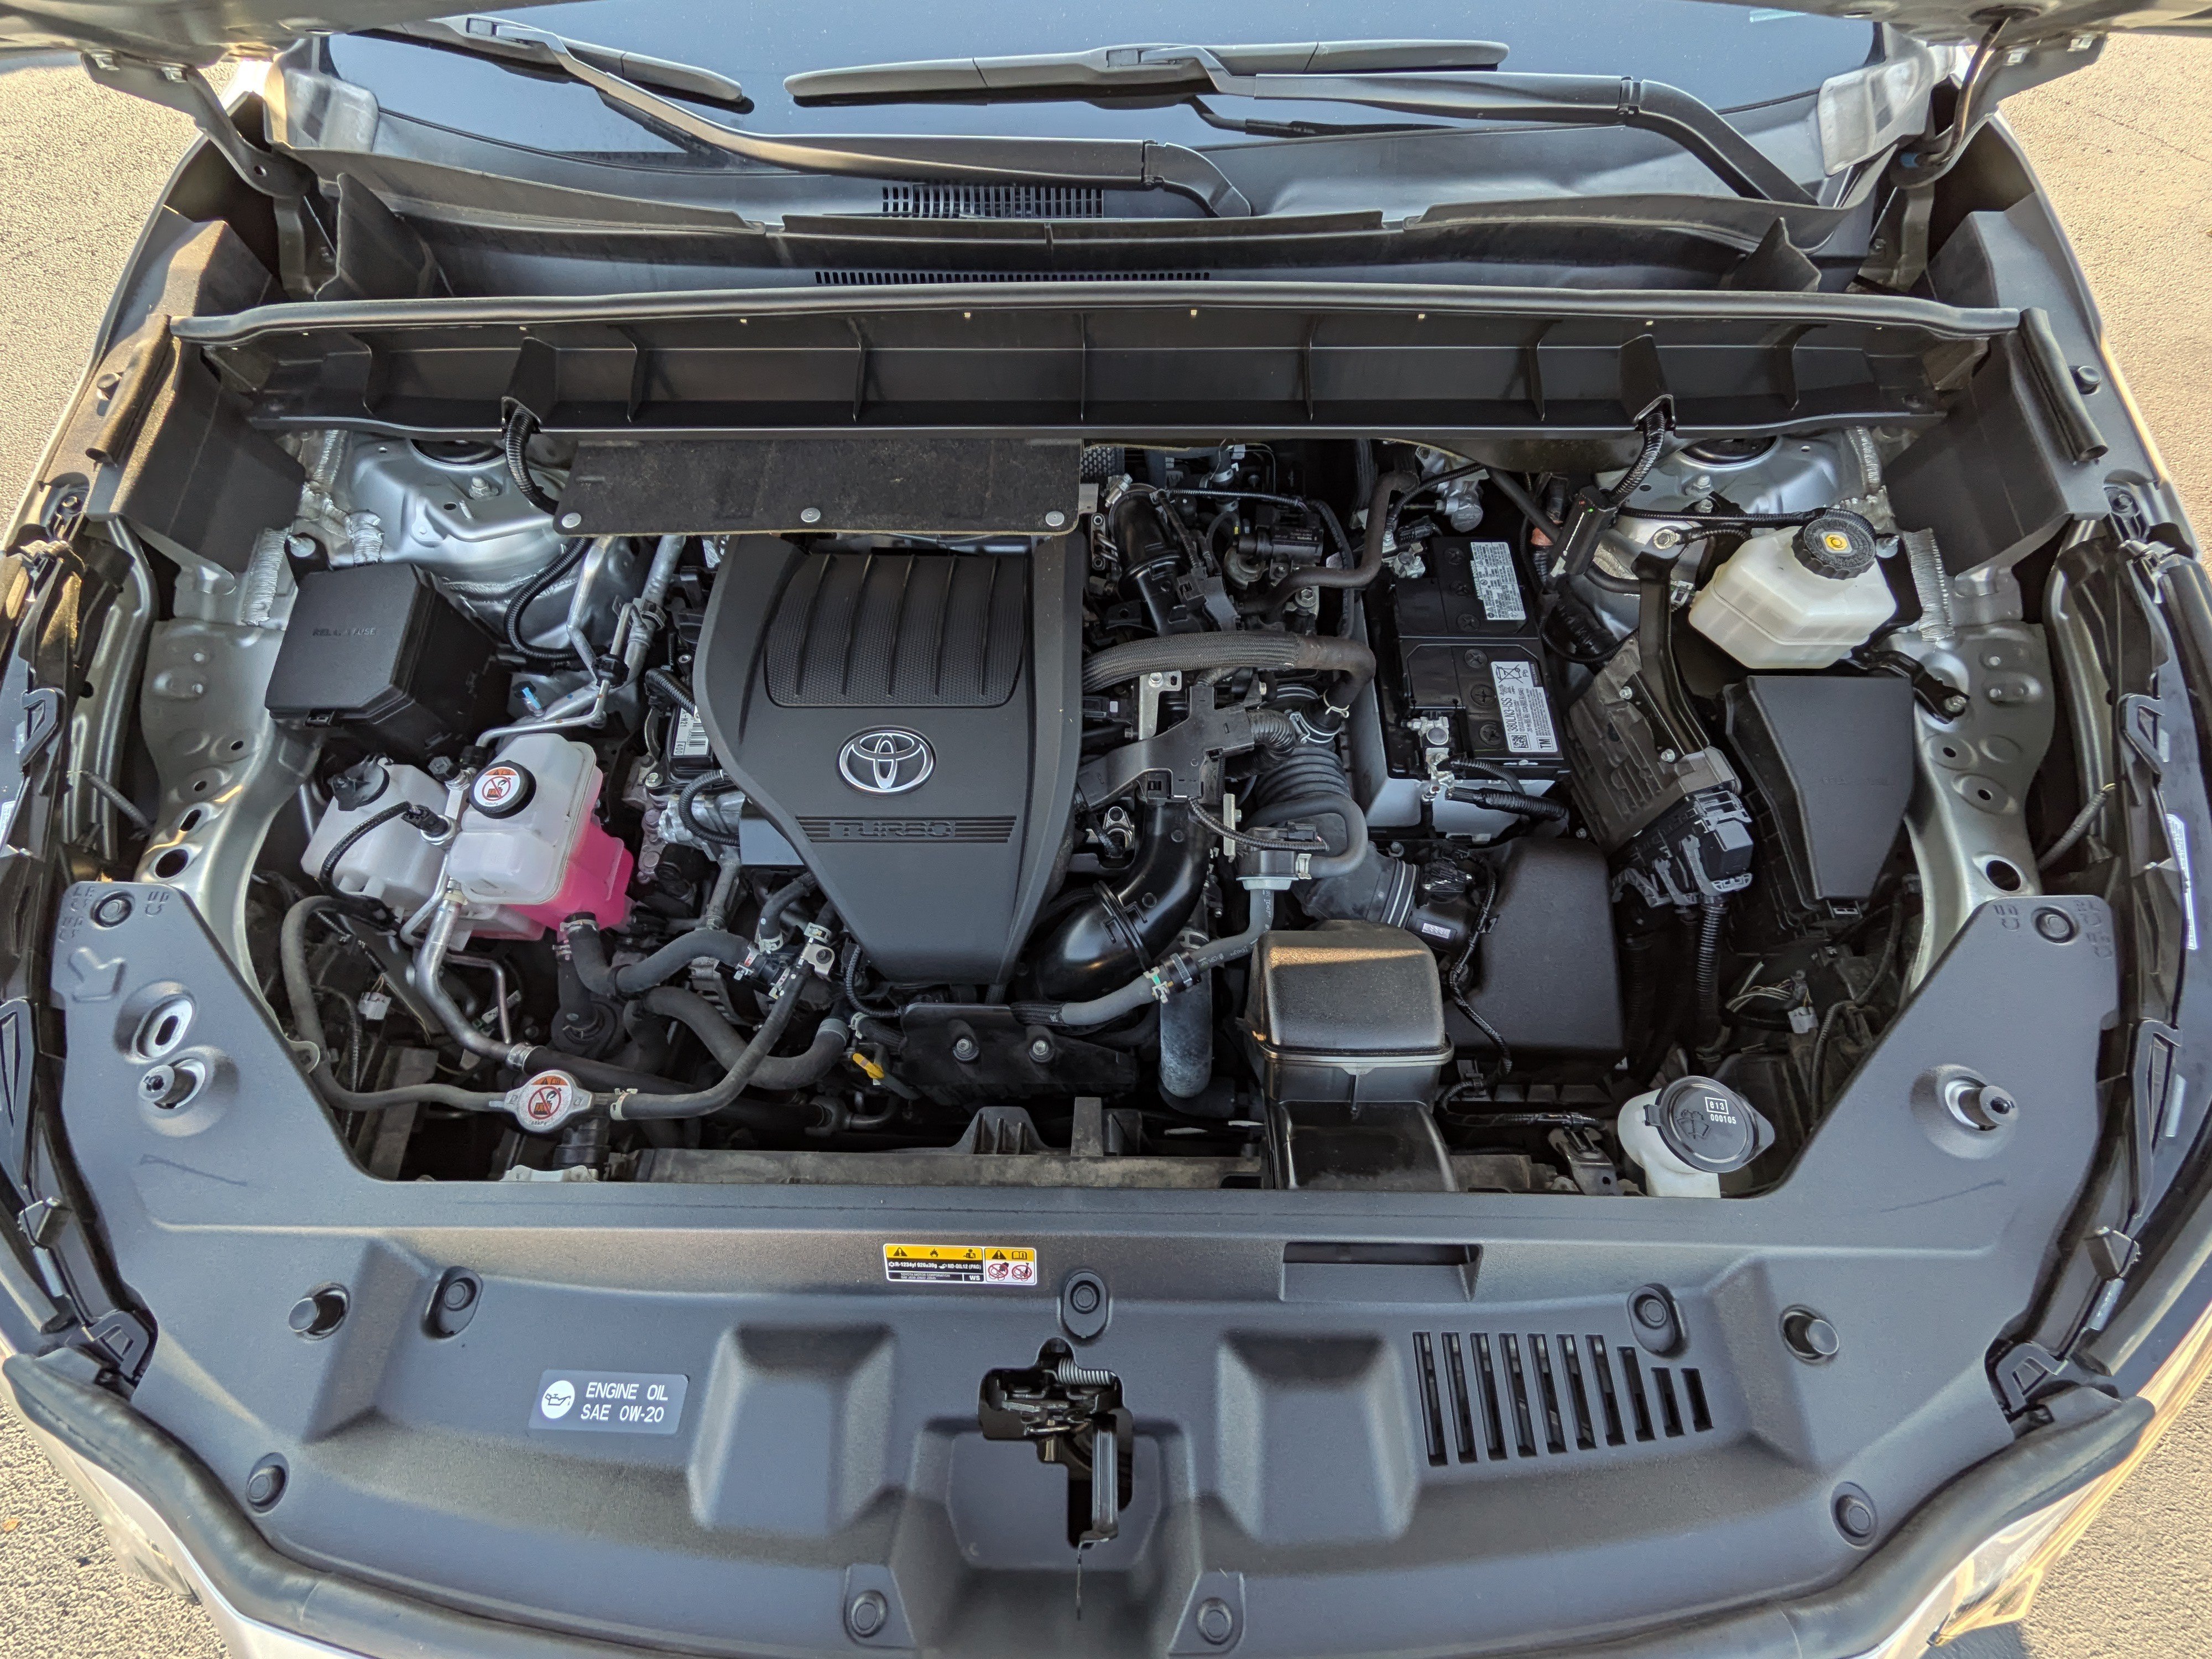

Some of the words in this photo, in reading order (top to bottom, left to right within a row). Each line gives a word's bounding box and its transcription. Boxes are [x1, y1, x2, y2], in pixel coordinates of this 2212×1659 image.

[1500, 697, 1519, 732] 380LN3-ISS
[675, 744, 684, 754] 400
[1538, 739, 1552, 749] TM
[834, 821, 952, 837] TURBO
[1710, 1113, 1736, 1124] 000105
[585, 1381, 639, 1400] ENGINE
[646, 1384, 669, 1401] OIL
[580, 1404, 612, 1421] SAE
[619, 1405, 665, 1423] 0W-20
